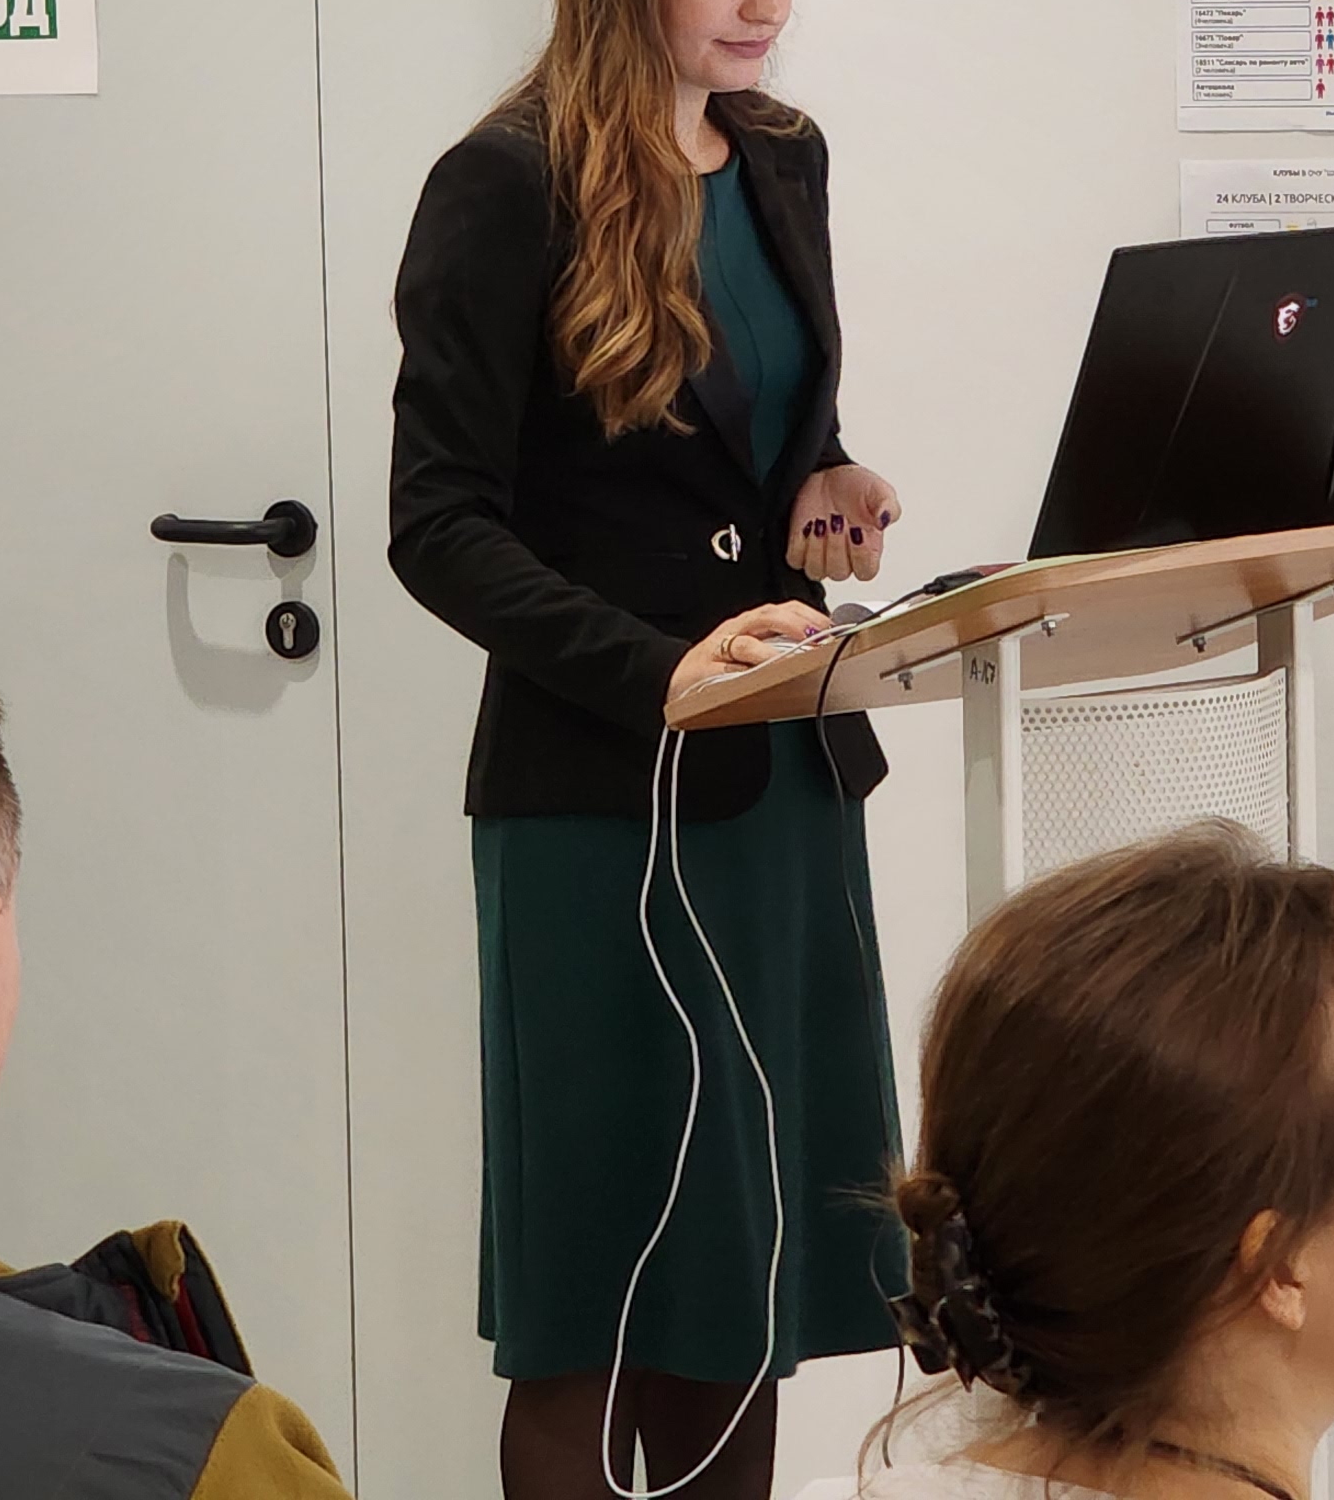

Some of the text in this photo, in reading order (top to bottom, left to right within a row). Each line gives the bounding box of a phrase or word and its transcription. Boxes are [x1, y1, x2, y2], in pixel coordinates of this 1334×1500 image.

[1216, 194, 1229, 204] 24
[1231, 194, 1266, 204] КЛУБА
[1274, 194, 1281, 204] 2
